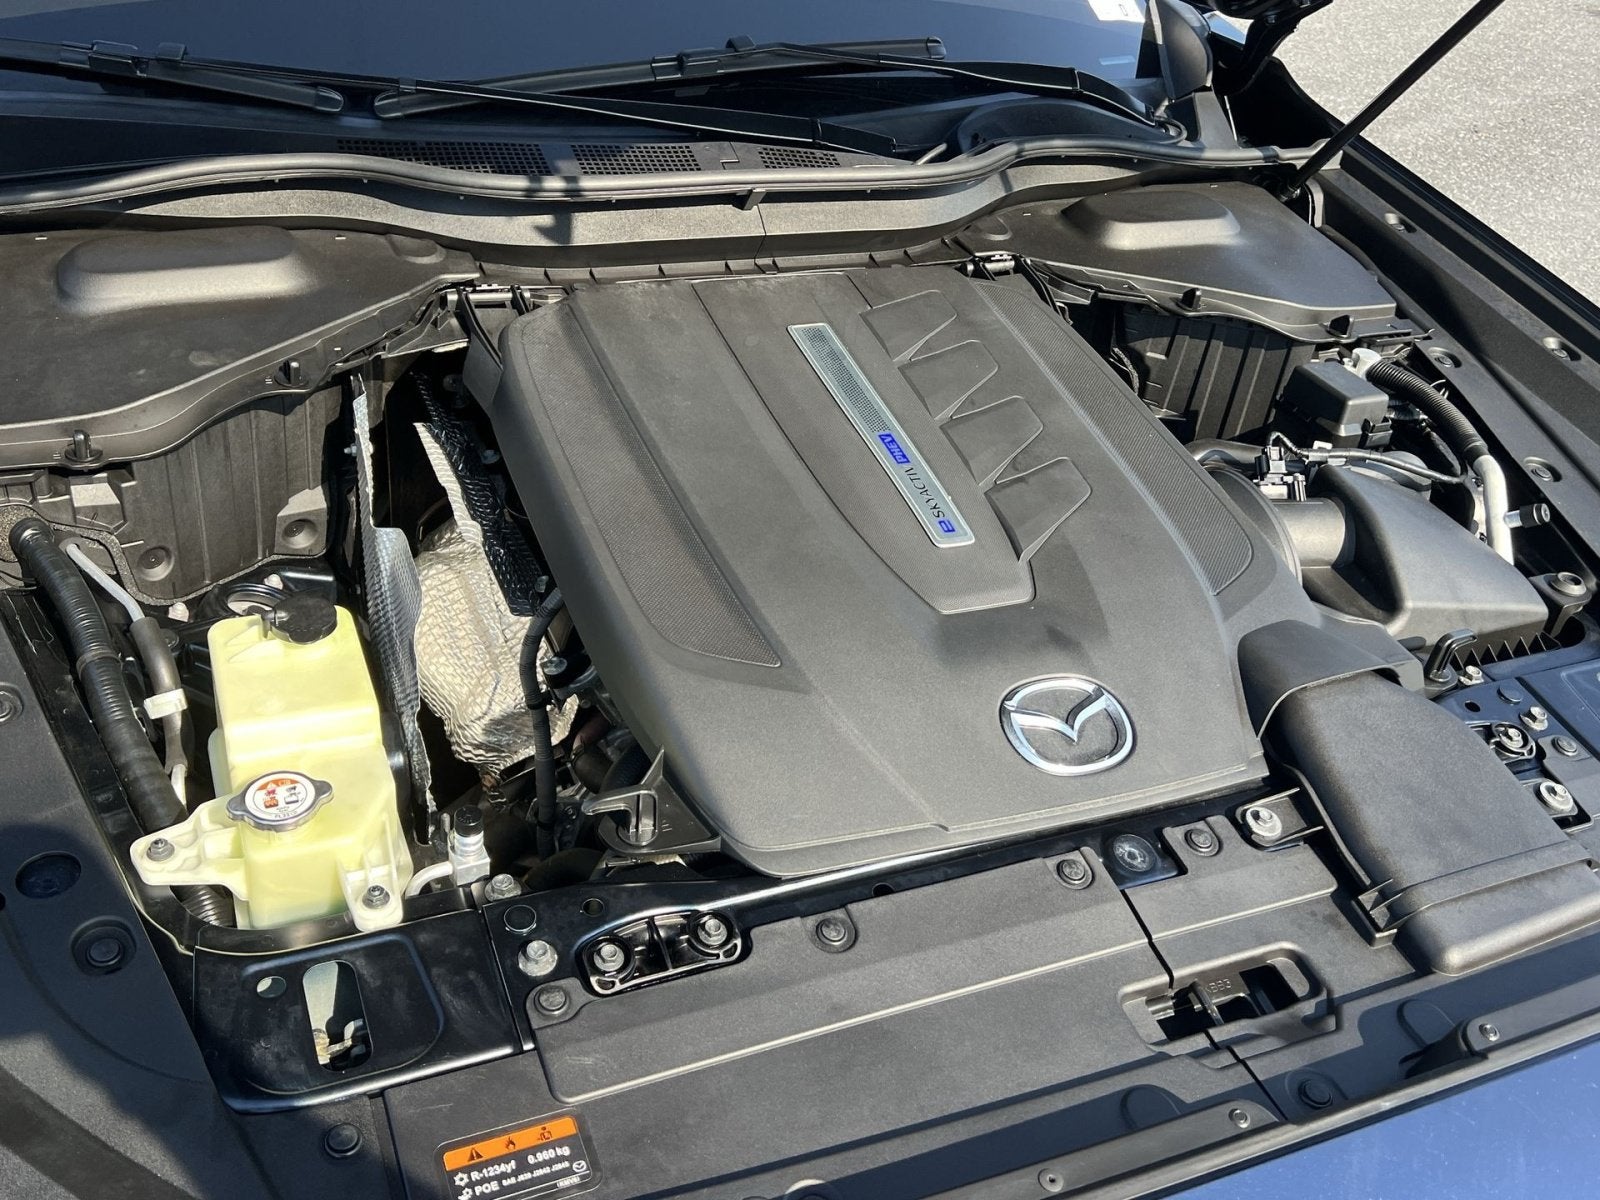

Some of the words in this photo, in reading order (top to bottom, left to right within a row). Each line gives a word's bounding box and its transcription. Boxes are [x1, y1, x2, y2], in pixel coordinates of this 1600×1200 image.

[879, 434, 910, 464] PHEV
[904, 466, 946, 518] SKYACTIV
[470, 1160, 516, 1181] R-1234yf
[527, 1149, 556, 1164] 0.960
[555, 1145, 571, 1157] kg
[474, 1181, 499, 1195] POE
